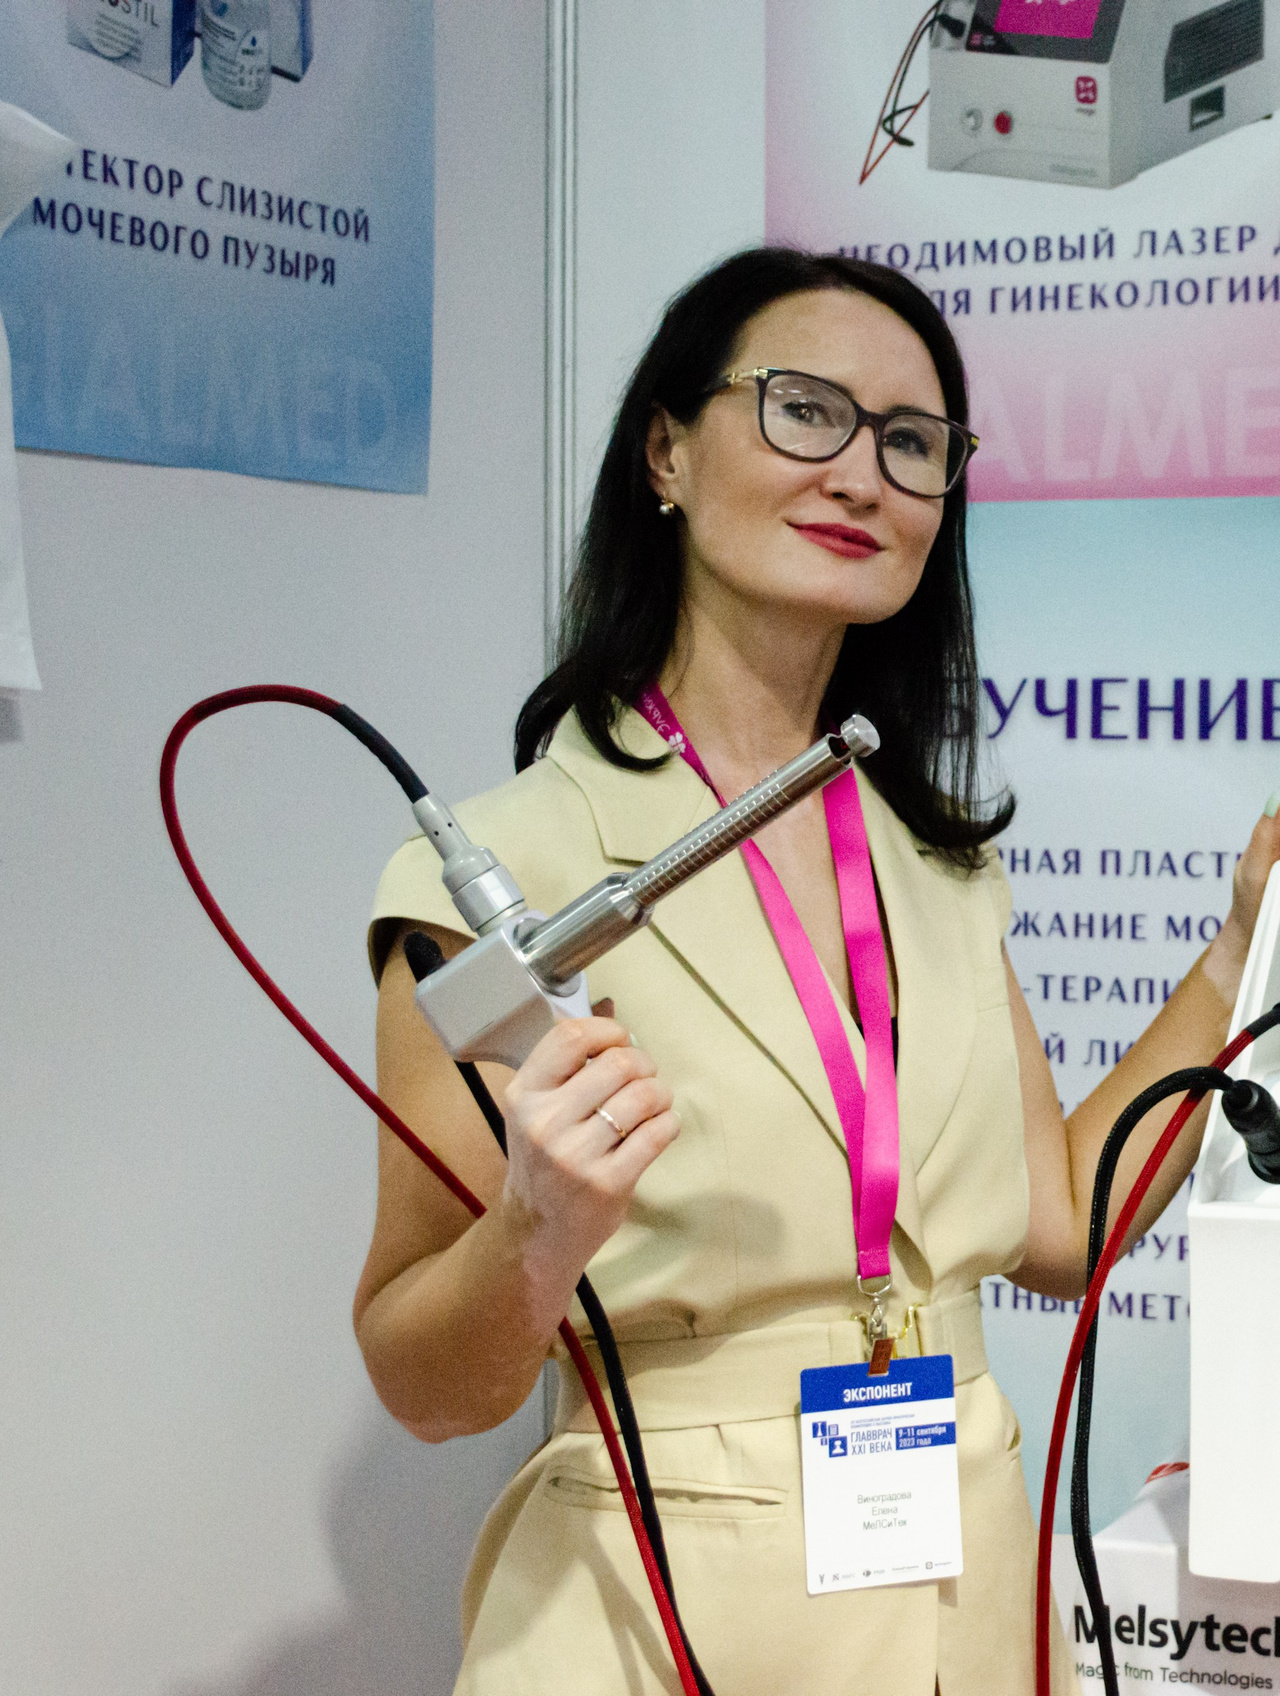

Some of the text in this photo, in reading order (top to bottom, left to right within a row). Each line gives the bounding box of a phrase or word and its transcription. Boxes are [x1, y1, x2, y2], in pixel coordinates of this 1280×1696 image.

[196, 176, 371, 244] СЛИЗИСТОЙ
[32, 196, 337, 287] МОЧЕВОГО ПУЗЫРЯ
[1133, 225, 1258, 260] ЛАЗЕР
[1108, 1291, 1190, 1321] МЕТ
[843, 1382, 913, 1403] ЭКСПОНЕНТ
[850, 1427, 893, 1443] ГЛАВВРАЧ
[851, 1440, 893, 1456] XXI ВЕКА
[898, 1437, 915, 1448] 2023
[1075, 1661, 1273, 1690] Magc from Technologies
